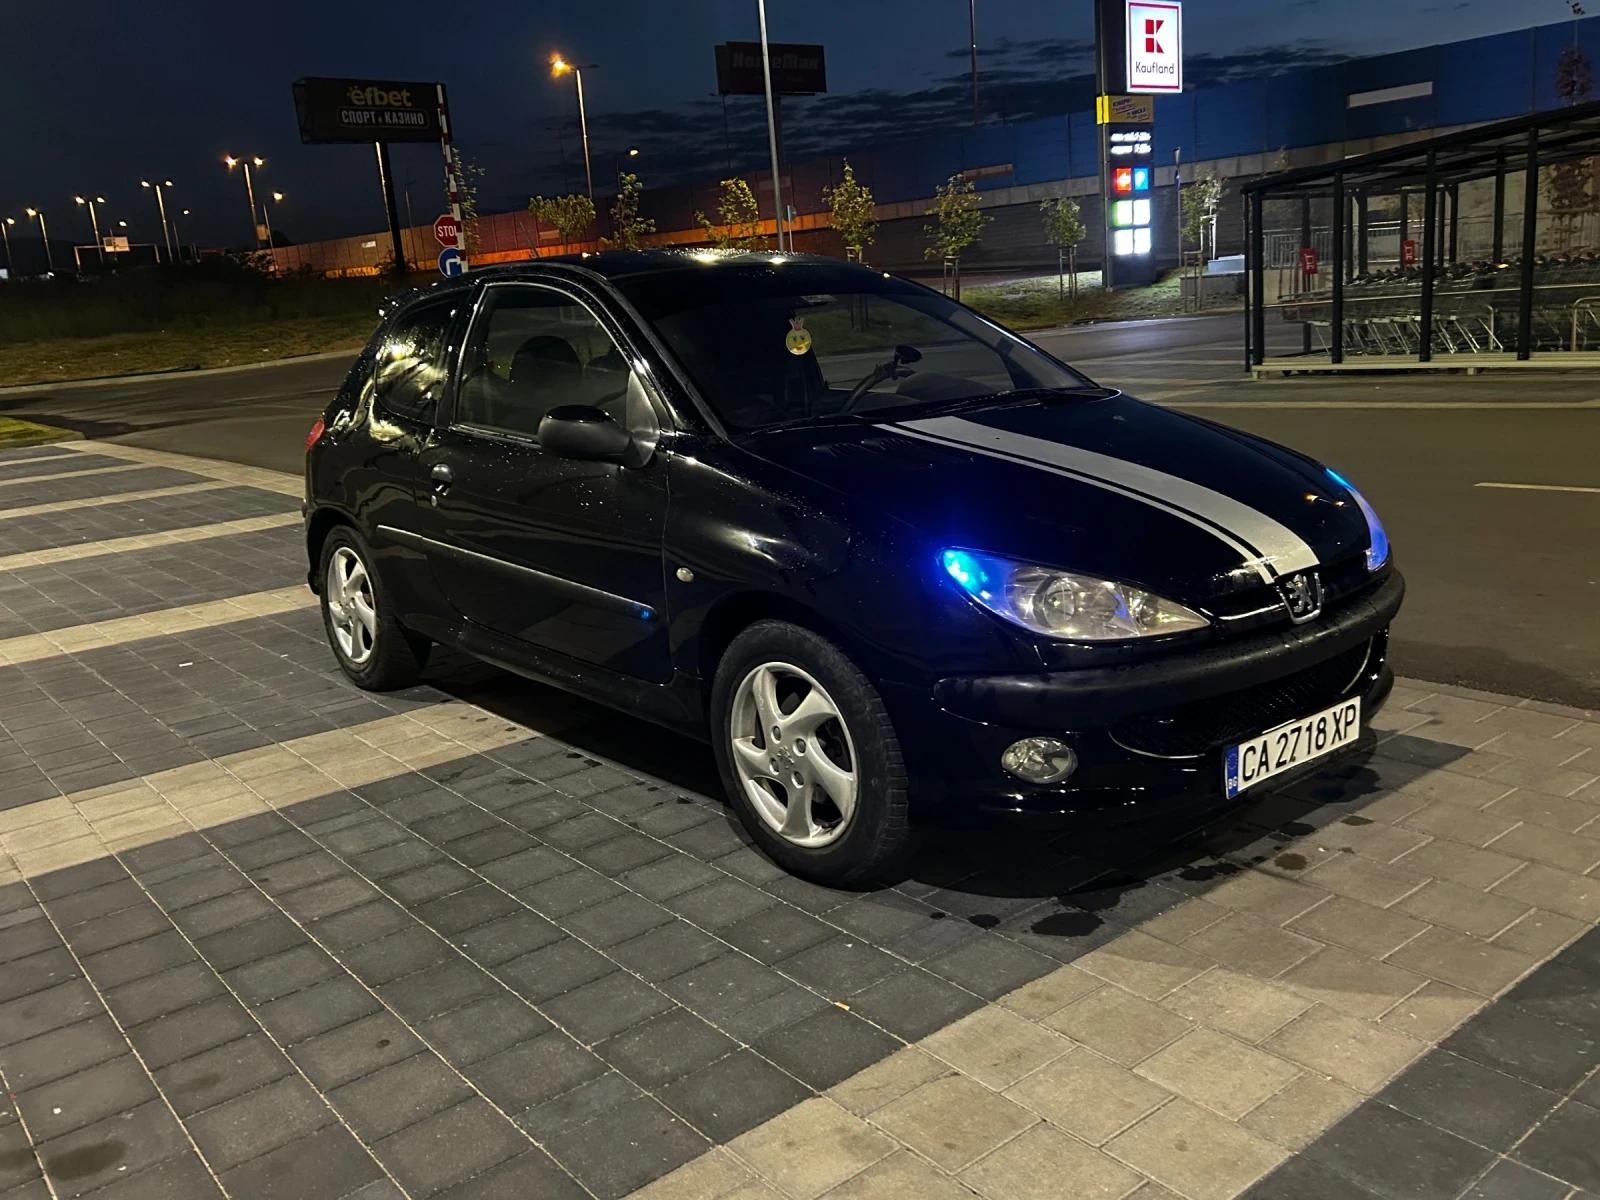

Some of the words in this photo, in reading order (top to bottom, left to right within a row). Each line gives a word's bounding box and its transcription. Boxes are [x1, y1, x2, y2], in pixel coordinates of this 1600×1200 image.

[1135, 61, 1175, 75] Kaufland
[341, 110, 376, 124] СПОРТ
[384, 111, 424, 125] КАЗИНО
[1242, 740, 1270, 782] CA
[1275, 716, 1327, 769] 2718
[1331, 703, 1357, 745] XP
[1228, 776, 1239, 790] BG
